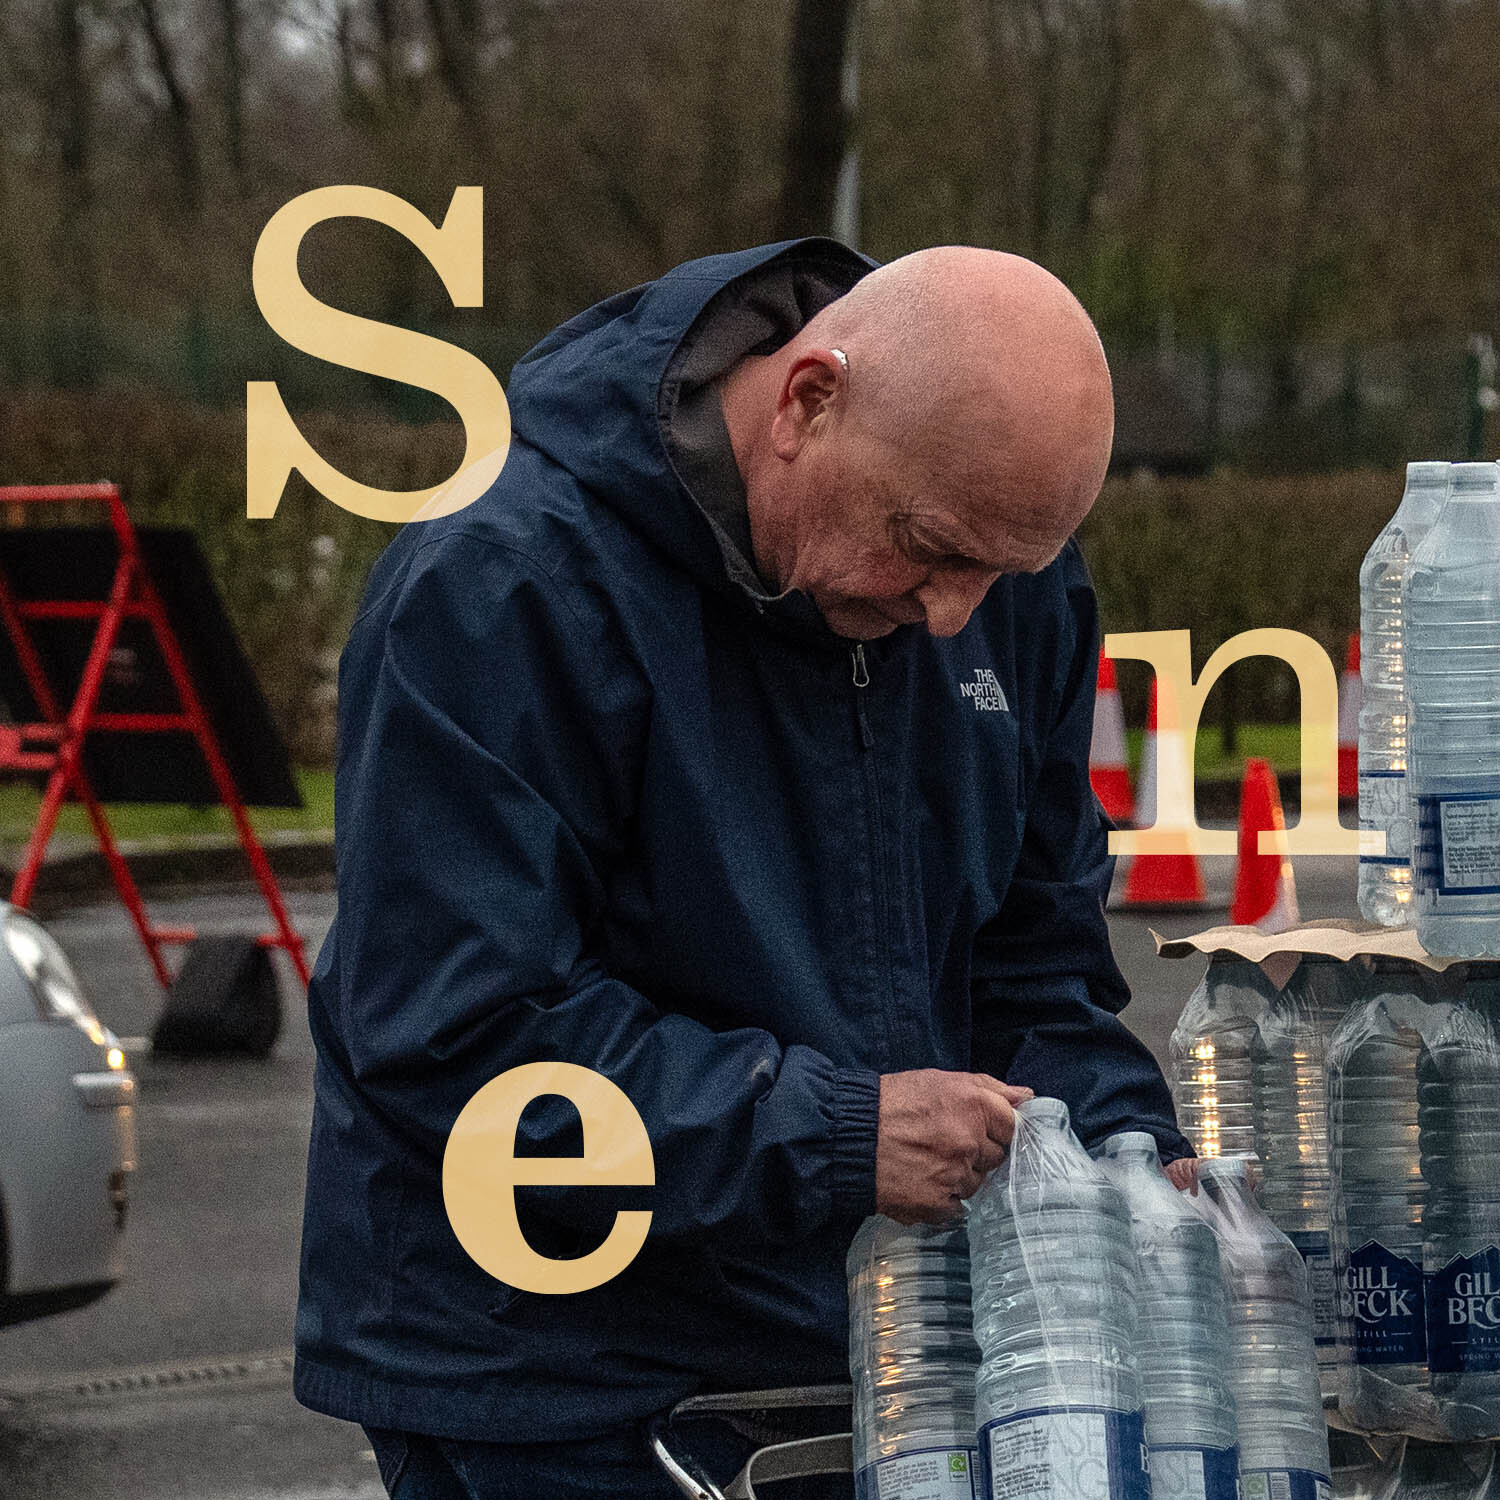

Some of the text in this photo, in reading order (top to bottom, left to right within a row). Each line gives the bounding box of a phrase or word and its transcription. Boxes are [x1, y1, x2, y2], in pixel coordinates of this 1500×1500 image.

[974, 669, 994, 682] THE
[960, 682, 998, 697] NORTH
[974, 697, 999, 711] FACE
[1343, 1265, 1398, 1291] GILL
[1341, 1288, 1413, 1324] BECK
